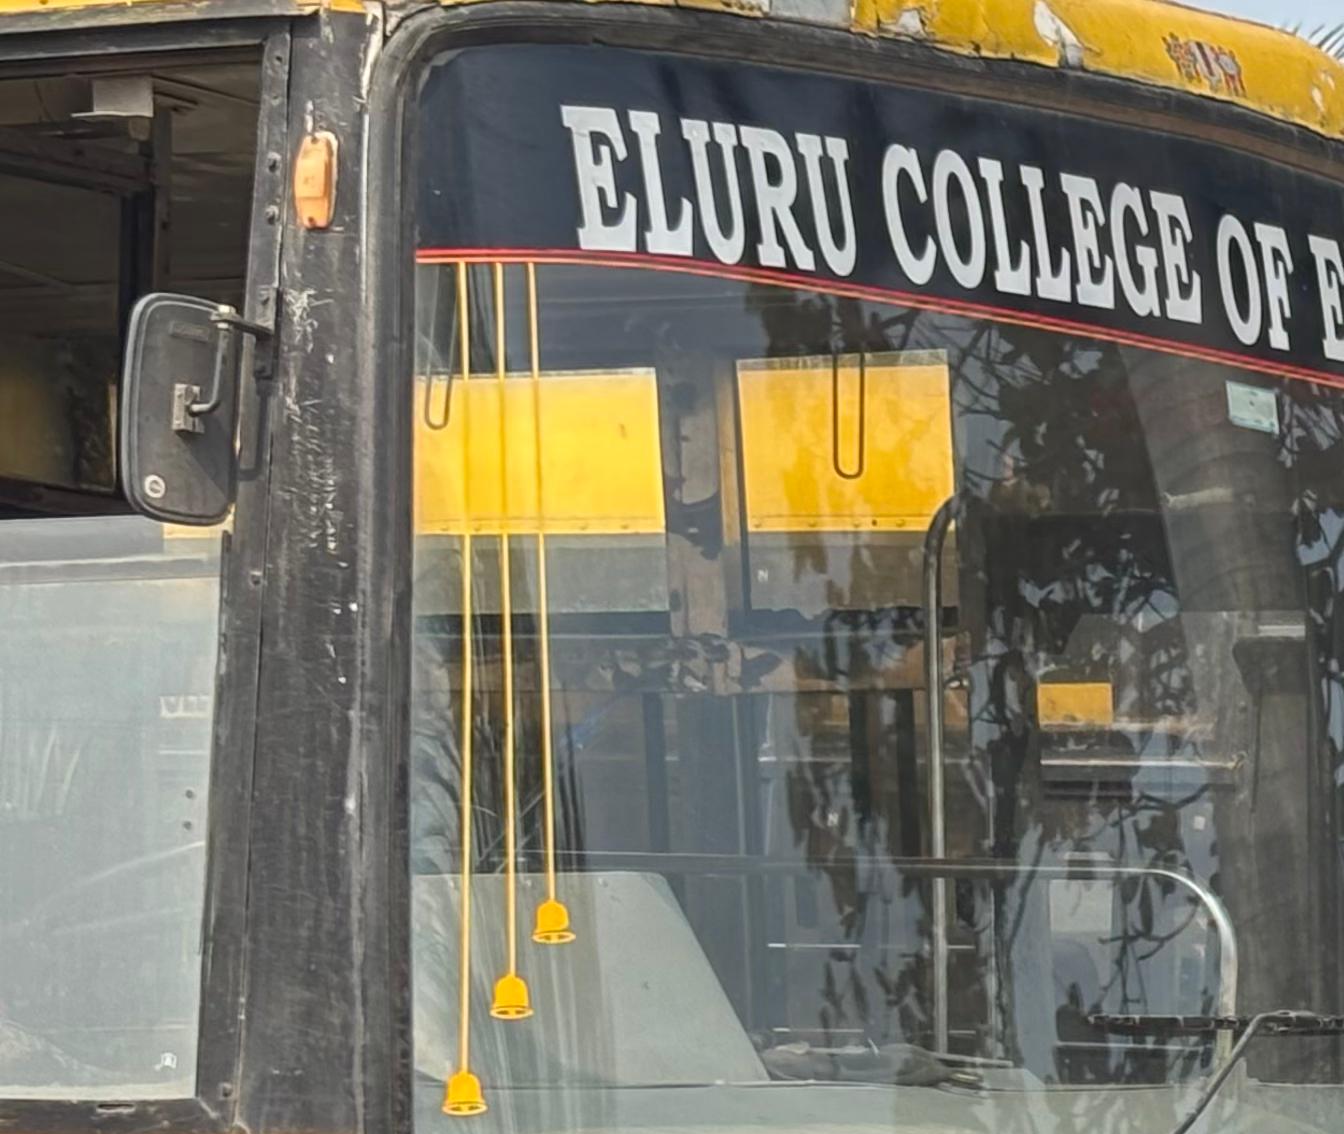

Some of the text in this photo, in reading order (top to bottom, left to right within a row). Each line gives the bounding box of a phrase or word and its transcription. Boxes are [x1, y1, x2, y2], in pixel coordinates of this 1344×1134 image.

[561, 104, 860, 278] ELURU
[881, 142, 1202, 326] COLLEGE
[1216, 213, 1295, 350] OF
